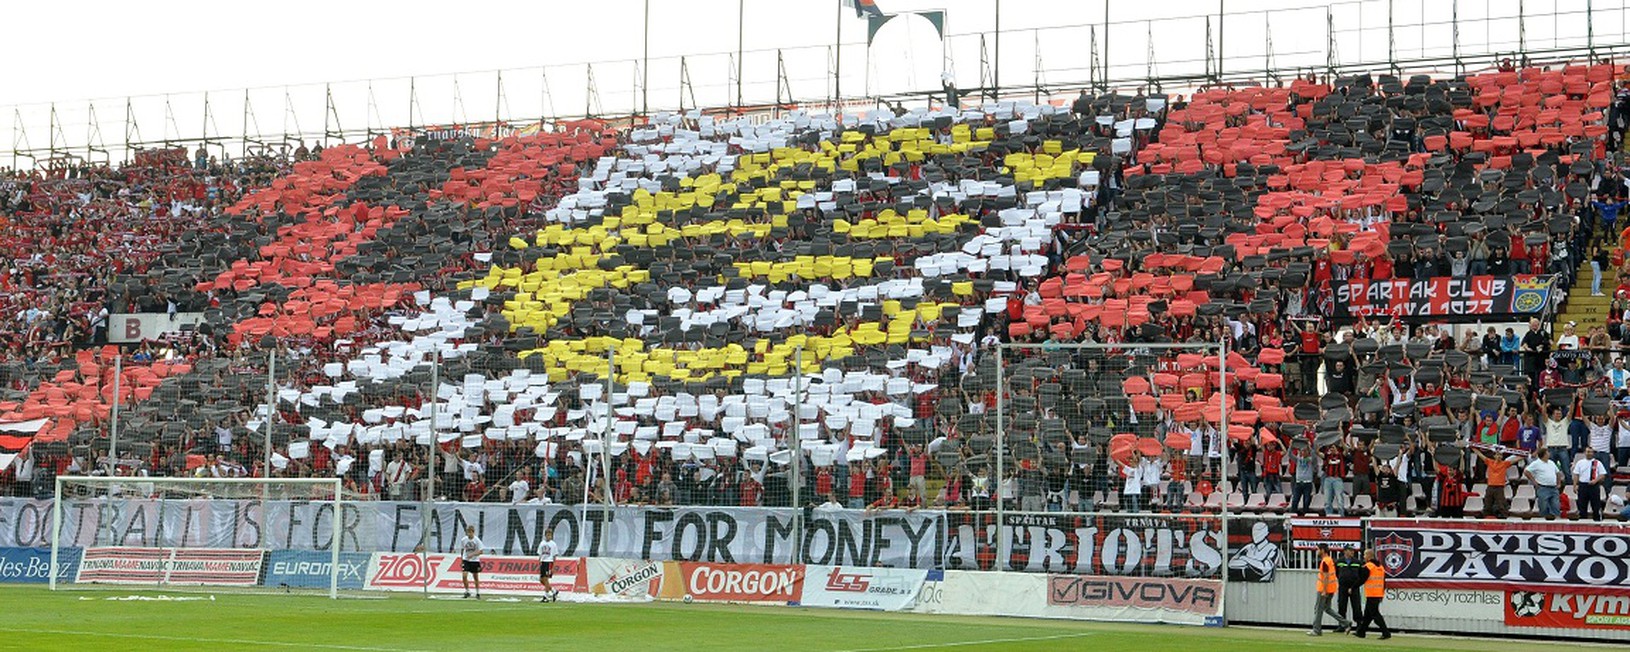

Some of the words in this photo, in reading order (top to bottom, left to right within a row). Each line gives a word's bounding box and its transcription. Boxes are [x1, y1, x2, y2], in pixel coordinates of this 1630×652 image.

[1337, 281, 1438, 303] SPARTAK
[1446, 280, 1507, 298] CLUB
[125, 318, 141, 339] B
[233, 501, 262, 549] IS
[286, 502, 362, 552] FOR
[503, 508, 615, 558] NOT
[641, 510, 738, 563] FOR
[1008, 515, 1058, 526] SPARTAK
[1124, 517, 1169, 528] TRNAVA
[272, 559, 367, 581] EUROMAX
[370, 553, 445, 587] ZOS
[690, 566, 797, 596] CORGOŇ
[1081, 580, 1216, 608] GIVOVA
[1385, 588, 1453, 606] Slovenský
[1453, 590, 1501, 605] rozhlas
